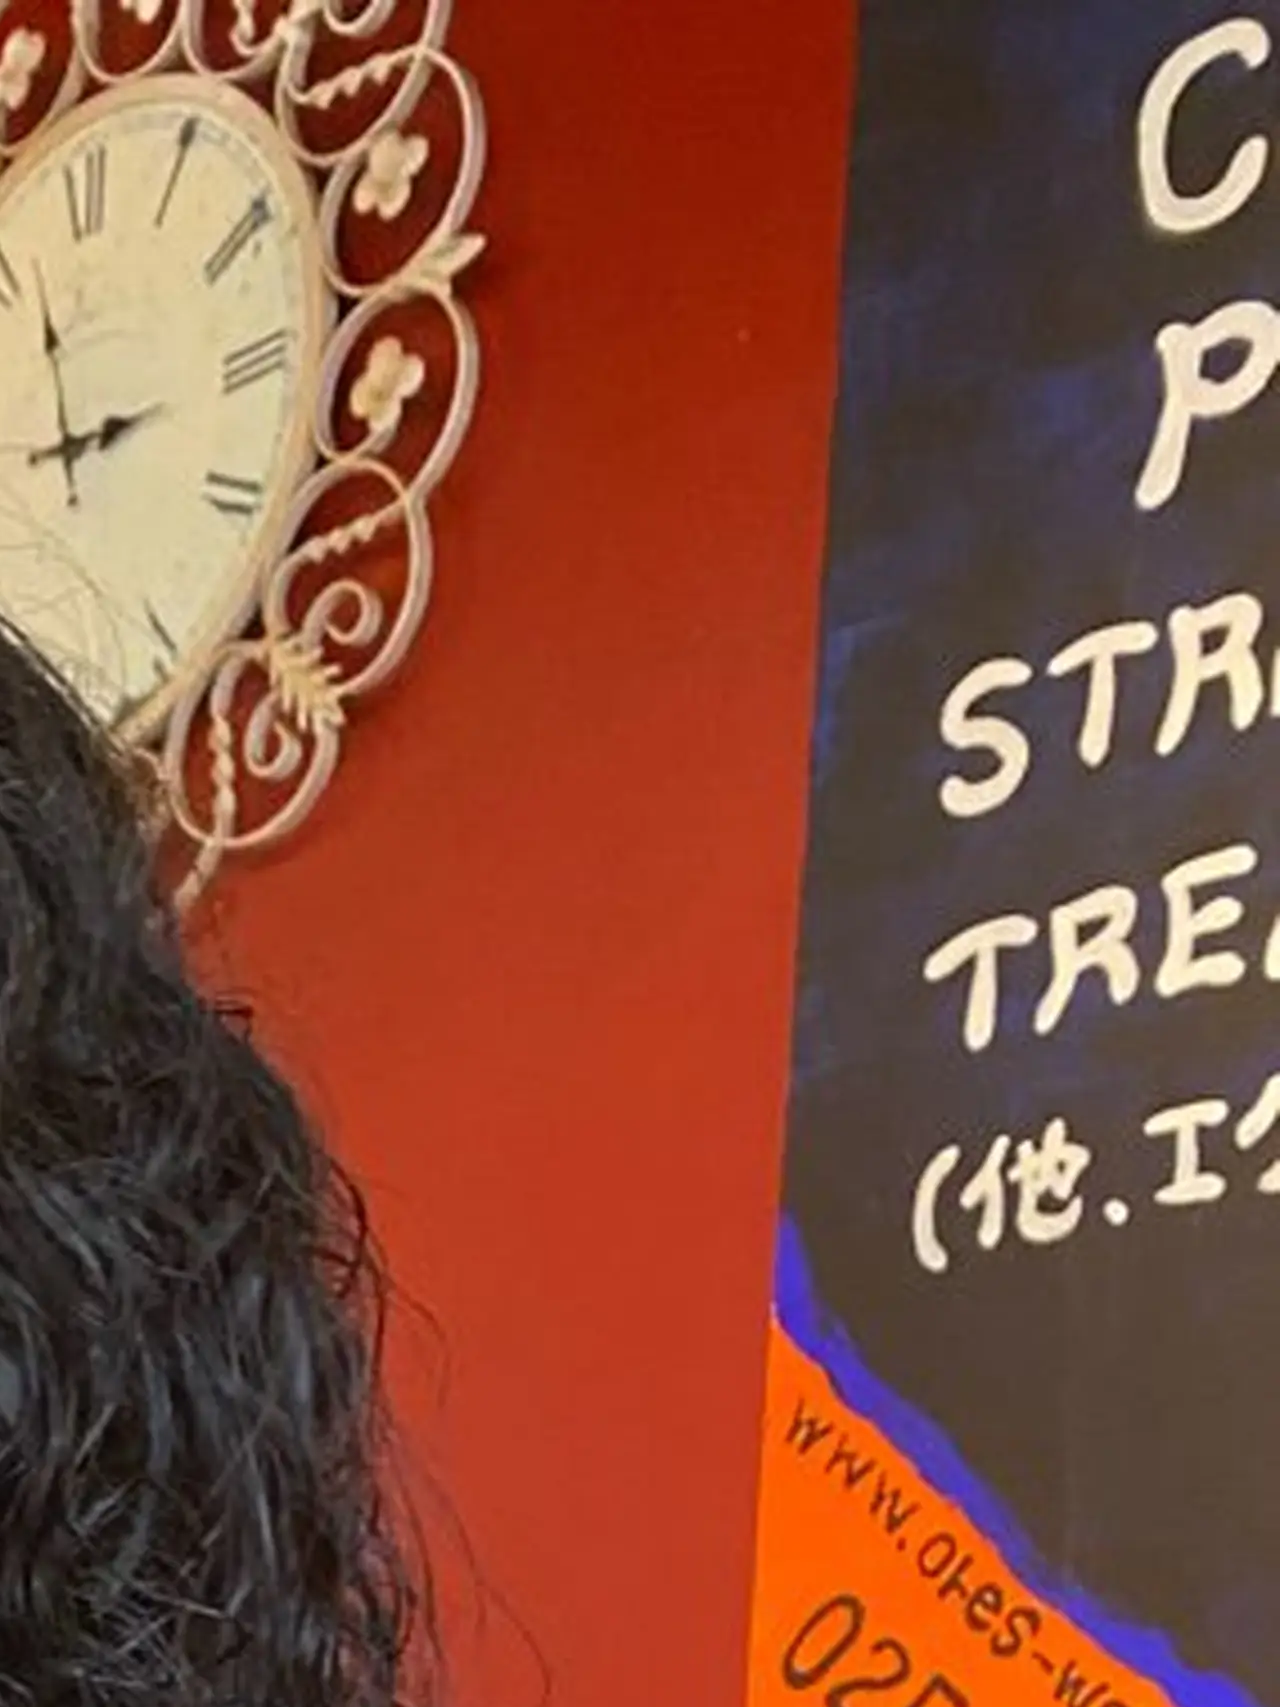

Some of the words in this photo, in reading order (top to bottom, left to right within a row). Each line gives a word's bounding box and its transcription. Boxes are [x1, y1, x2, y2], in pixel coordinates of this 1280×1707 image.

[1137, 17, 1270, 233] C
[1134, 299, 1280, 511] P
[939, 593, 1280, 818] STR
[922, 843, 1280, 1053] TRE
